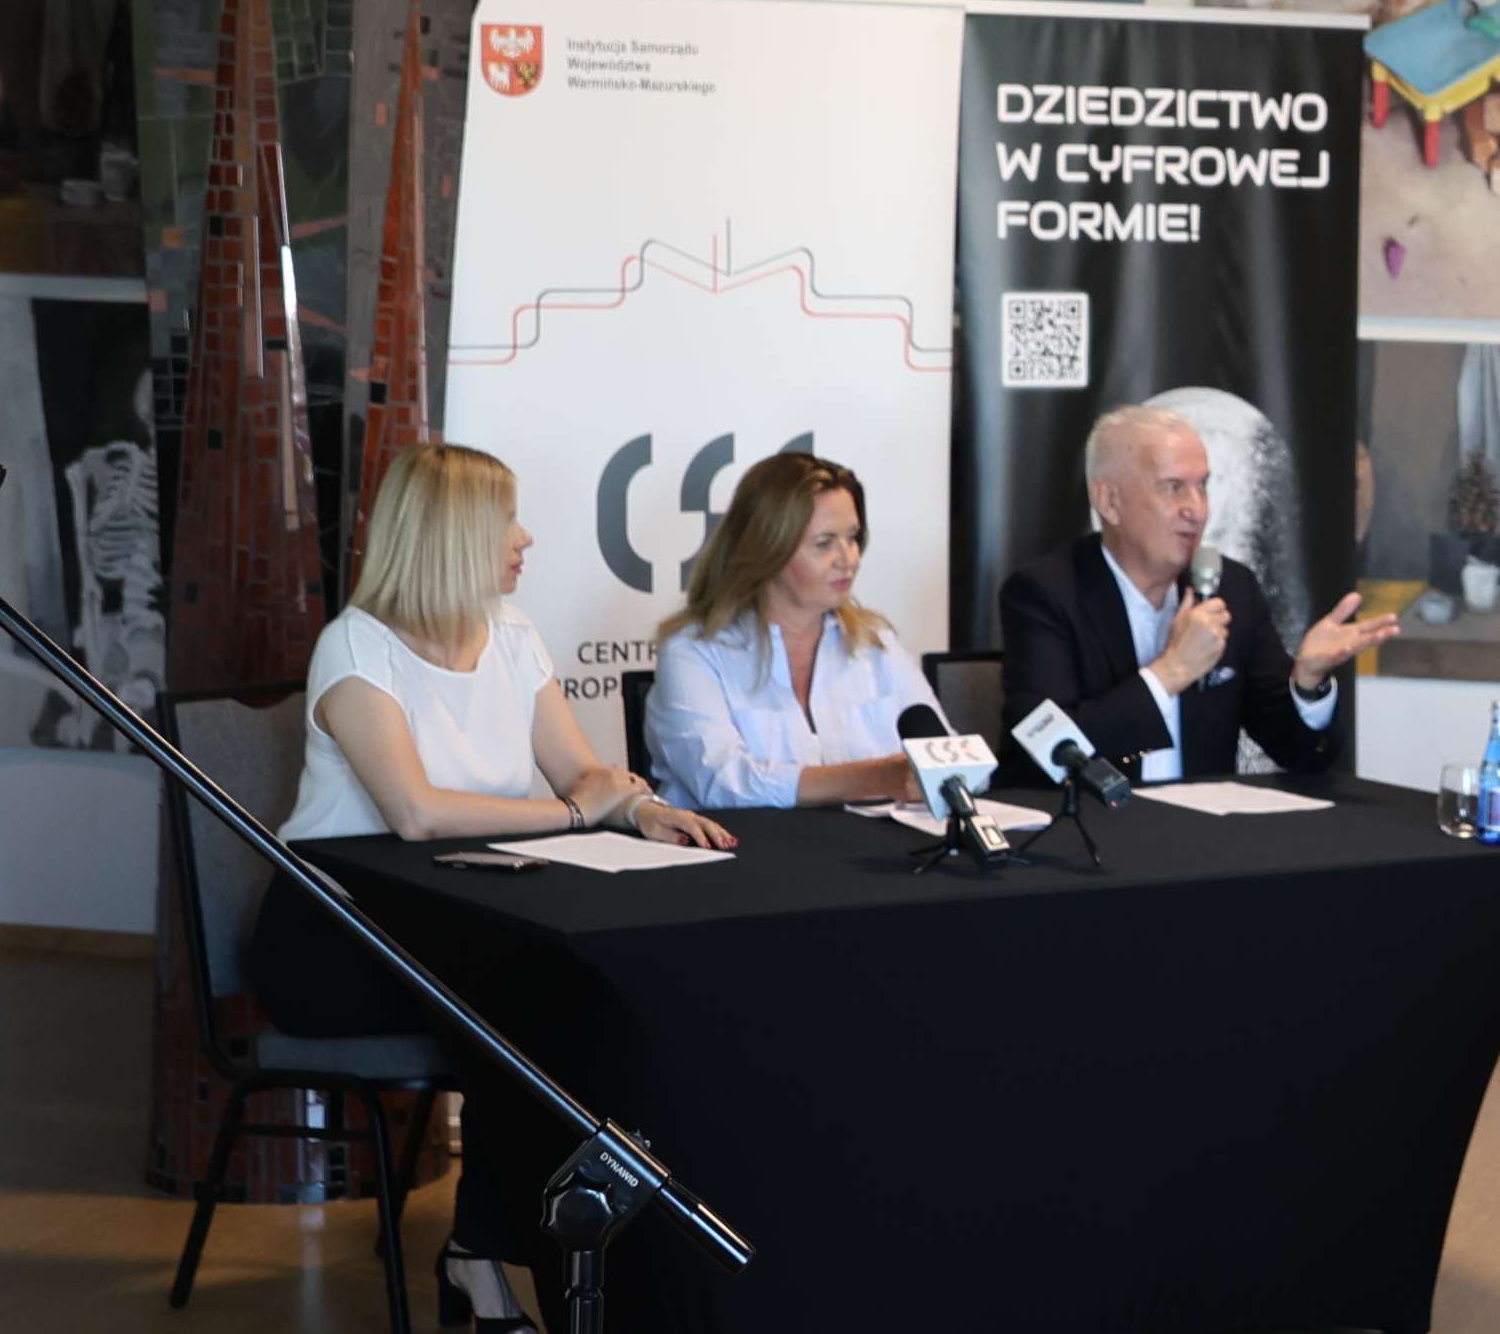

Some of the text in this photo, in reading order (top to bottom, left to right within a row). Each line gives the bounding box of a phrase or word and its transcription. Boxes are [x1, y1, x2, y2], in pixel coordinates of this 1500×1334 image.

[566, 38, 699, 56] Instytucja Samorządu
[566, 57, 652, 74] Województwa
[566, 75, 717, 95] Warmińsko-Mazurskiego
[997, 83, 1328, 132] DZIEDZICTWO
[996, 142, 1330, 189] W CYFROWEJ
[997, 201, 1201, 242] FORMIE!
[556, 676, 618, 700] ROP
